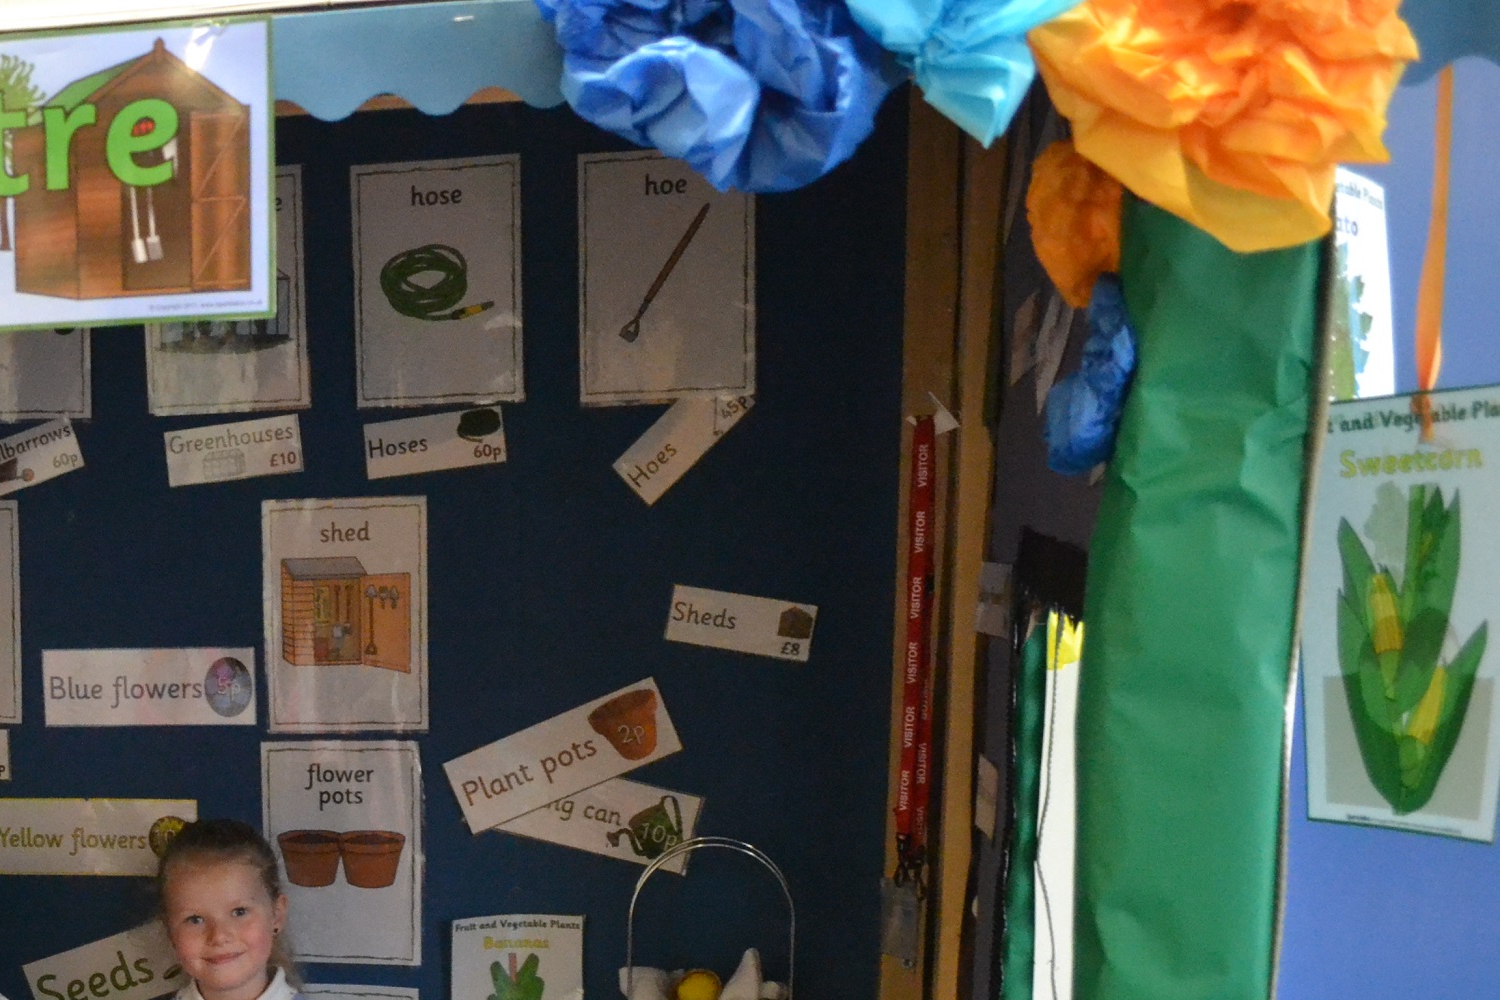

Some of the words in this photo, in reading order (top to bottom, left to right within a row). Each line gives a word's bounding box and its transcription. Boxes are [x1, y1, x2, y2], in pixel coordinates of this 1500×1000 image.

[411, 185, 462, 207] hose
[644, 173, 687, 196] hoe
[721, 396, 749, 420] 45p
[1339, 411, 1374, 432] and
[169, 424, 295, 455] Greenhouses
[367, 435, 429, 459] Hoses
[473, 442, 502, 461] 60p
[52, 451, 79, 470] 60p
[269, 450, 297, 467] £10
[627, 443, 677, 487] Hoes
[917, 444, 929, 488] VISITOR
[1340, 449, 1483, 478] Sweetcorn
[319, 521, 371, 543] shed
[914, 510, 926, 554] VISITOR
[910, 576, 922, 619] VISITOR
[672, 600, 737, 630] Sheds
[781, 642, 800, 656] £8
[908, 641, 918, 685] VISITOR
[49, 675, 103, 701] Blue
[110, 674, 204, 709] flowers
[217, 677, 241, 701] 5p
[617, 724, 645, 745] 2p
[904, 706, 915, 748] VISITOR
[461, 763, 534, 807] Plant
[540, 739, 598, 784] pots
[917, 742, 927, 784] VISITOR
[304, 763, 374, 790] flower
[319, 788, 364, 811] pots
[899, 770, 910, 811] VISITOR
[583, 803, 622, 827] can
[69, 827, 147, 857] flowers
[642, 822, 678, 850] 10p
[479, 920, 497, 930] and
[500, 919, 547, 931] Vegetable
[550, 919, 580, 930] Plants
[483, 936, 549, 950] Bananas
